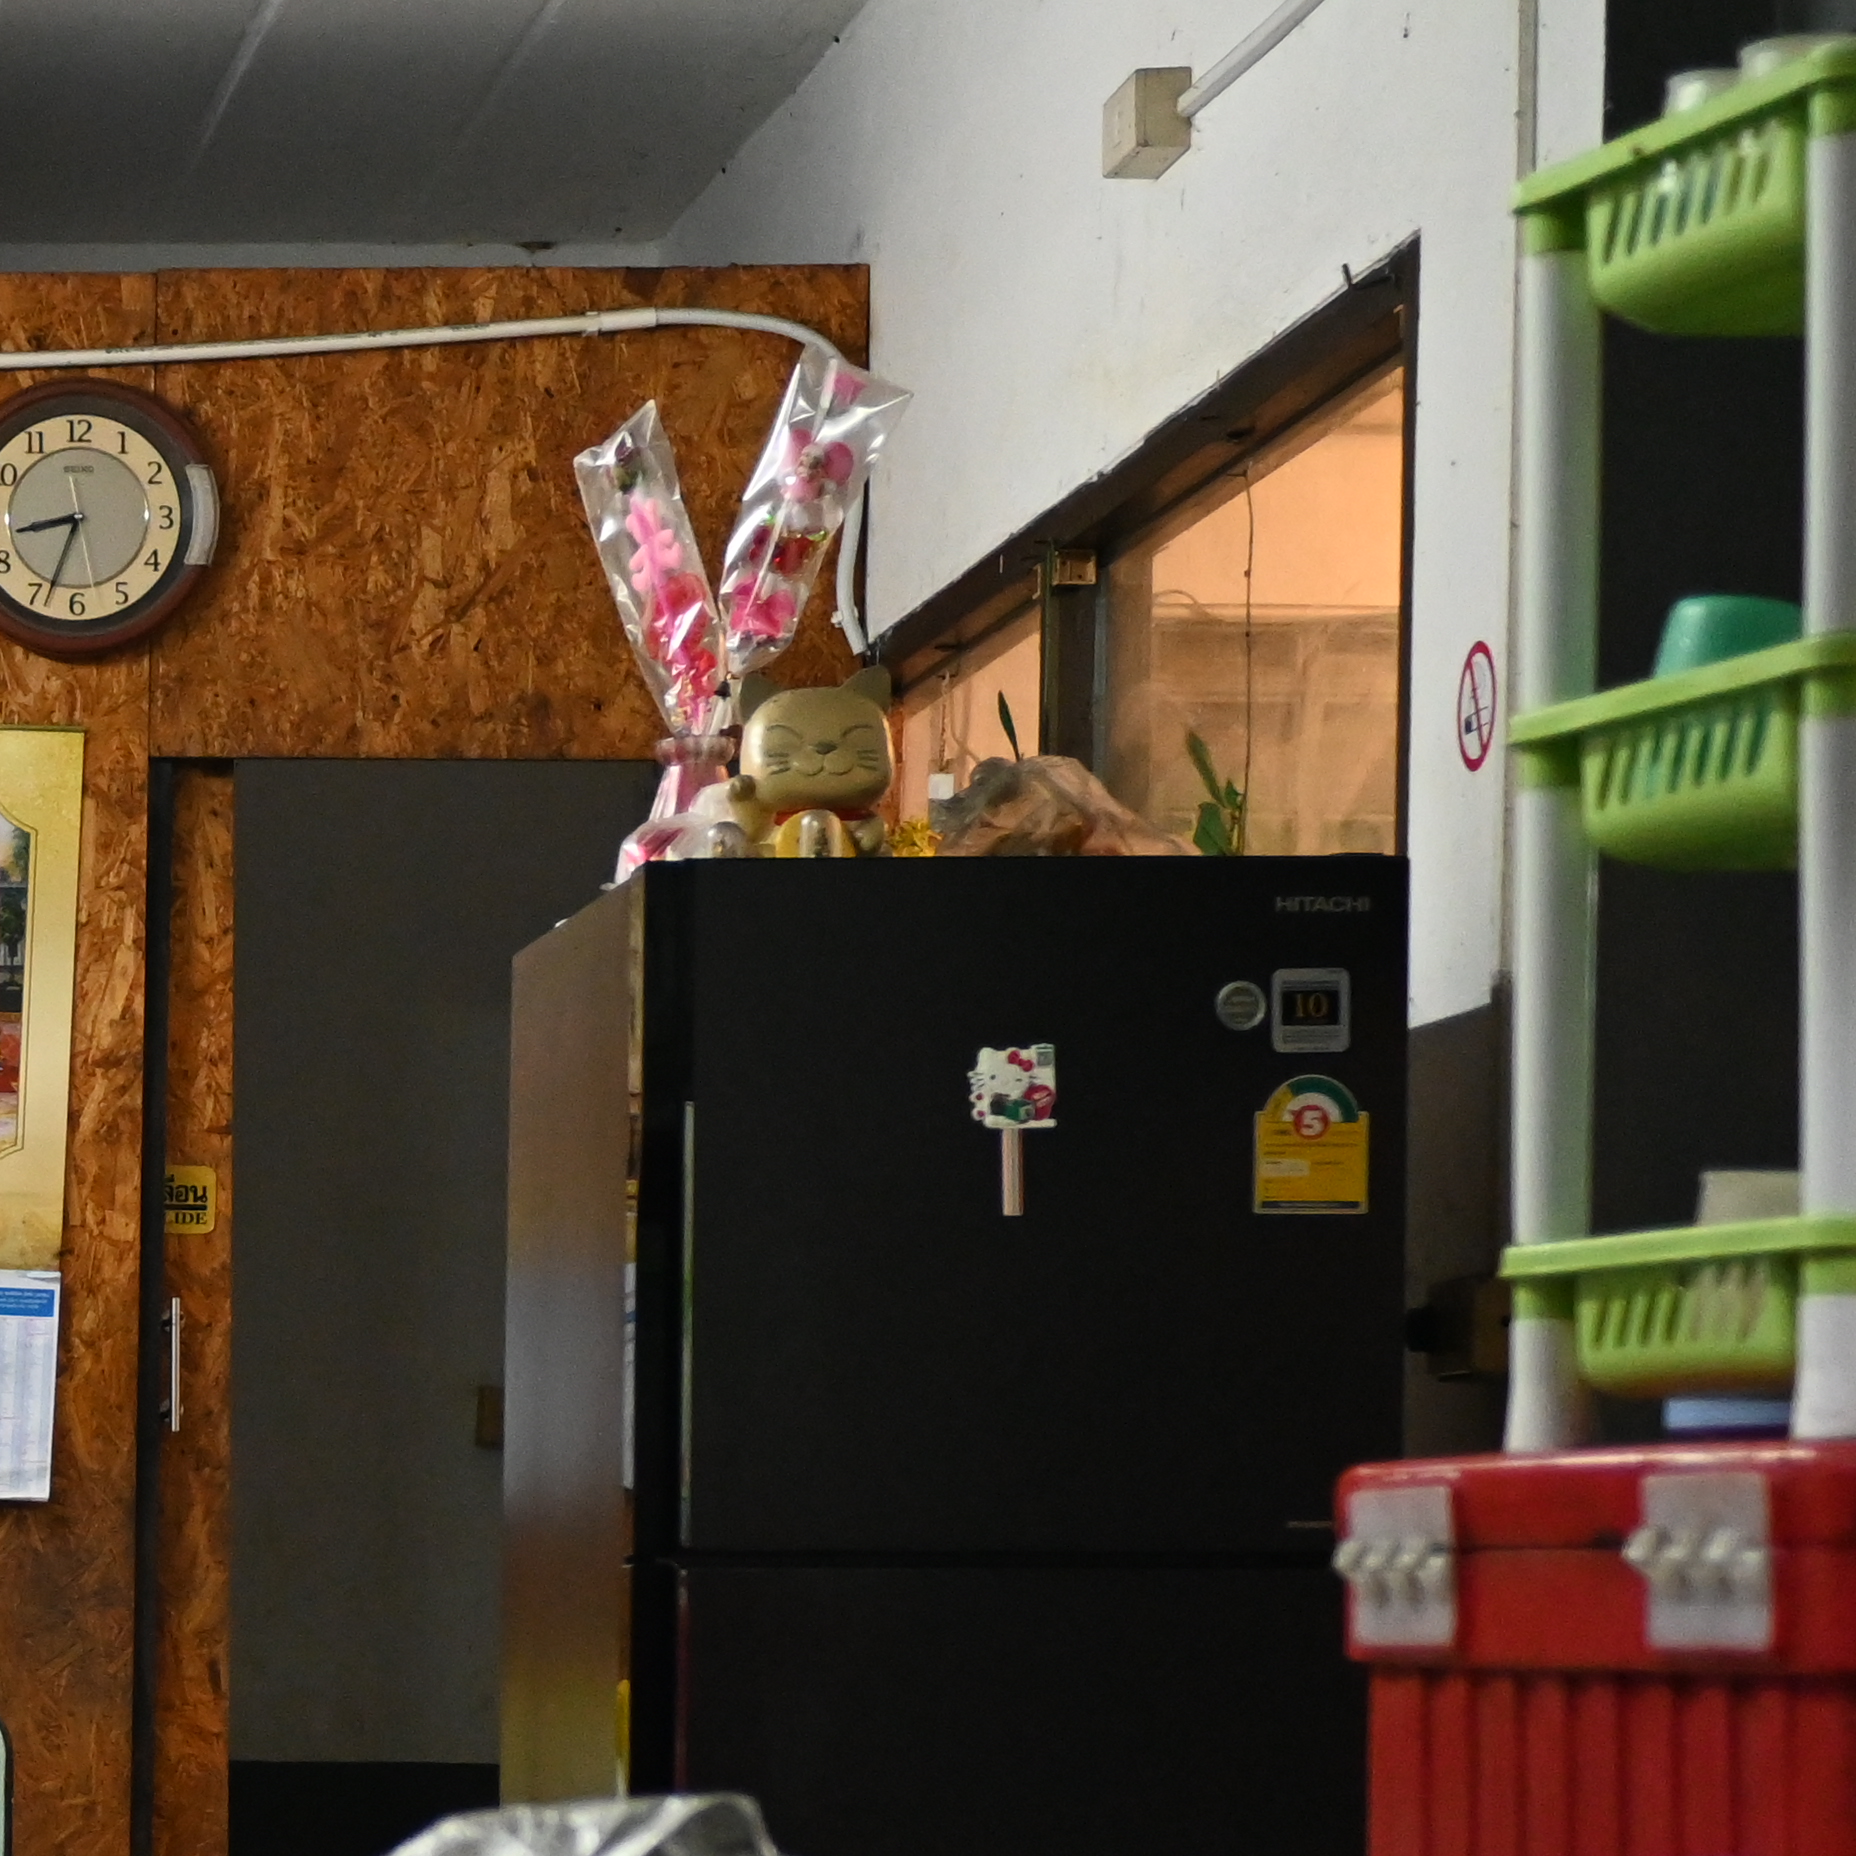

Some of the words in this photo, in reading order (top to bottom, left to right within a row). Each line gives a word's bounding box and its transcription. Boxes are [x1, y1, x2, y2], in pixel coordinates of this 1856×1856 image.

[67, 420, 92, 442] 12
[24, 431, 44, 454] 11
[118, 432, 127, 454] 1
[148, 461, 163, 484] 2
[160, 506, 173, 529] 3
[144, 549, 160, 571] 4
[28, 583, 43, 605] 7
[69, 593, 85, 615] 6
[116, 582, 129, 604] 5
[1276, 896, 1370, 912] HITACHI
[1295, 993, 1328, 1017] 10
[1301, 1110, 1322, 1137] 5
[166, 1212, 207, 1225] IDE
